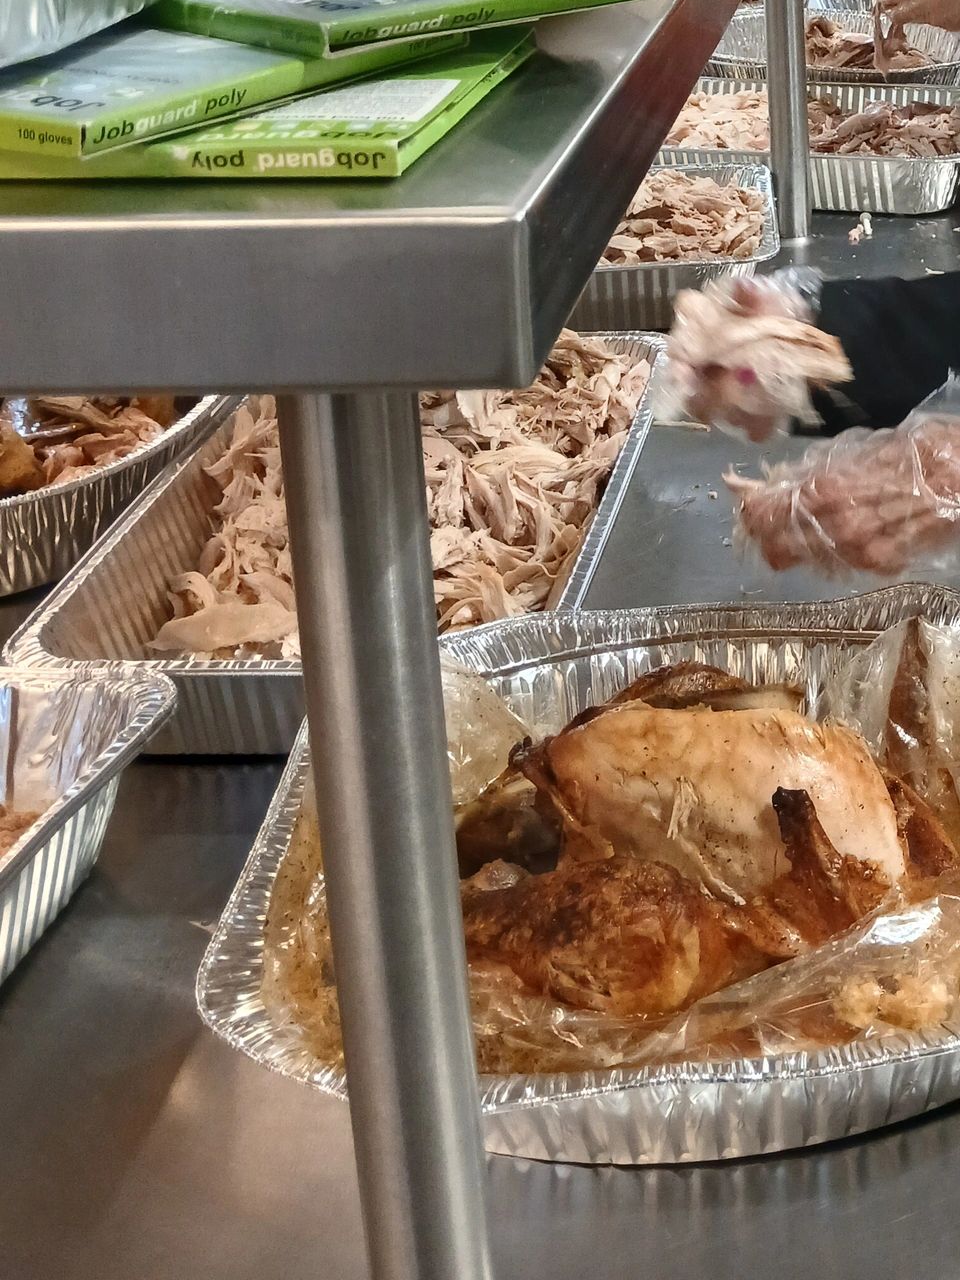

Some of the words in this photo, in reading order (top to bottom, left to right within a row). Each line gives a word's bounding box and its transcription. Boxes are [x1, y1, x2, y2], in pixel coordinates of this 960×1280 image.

[450, 7, 496, 26] poly
[92, 99, 198, 145] Jobguard
[204, 87, 248, 114] poly
[17, 128, 36, 141] 100
[38, 131, 74, 146] gloves
[191, 149, 245, 171] poly
[256, 147, 387, 173] Jobguard
